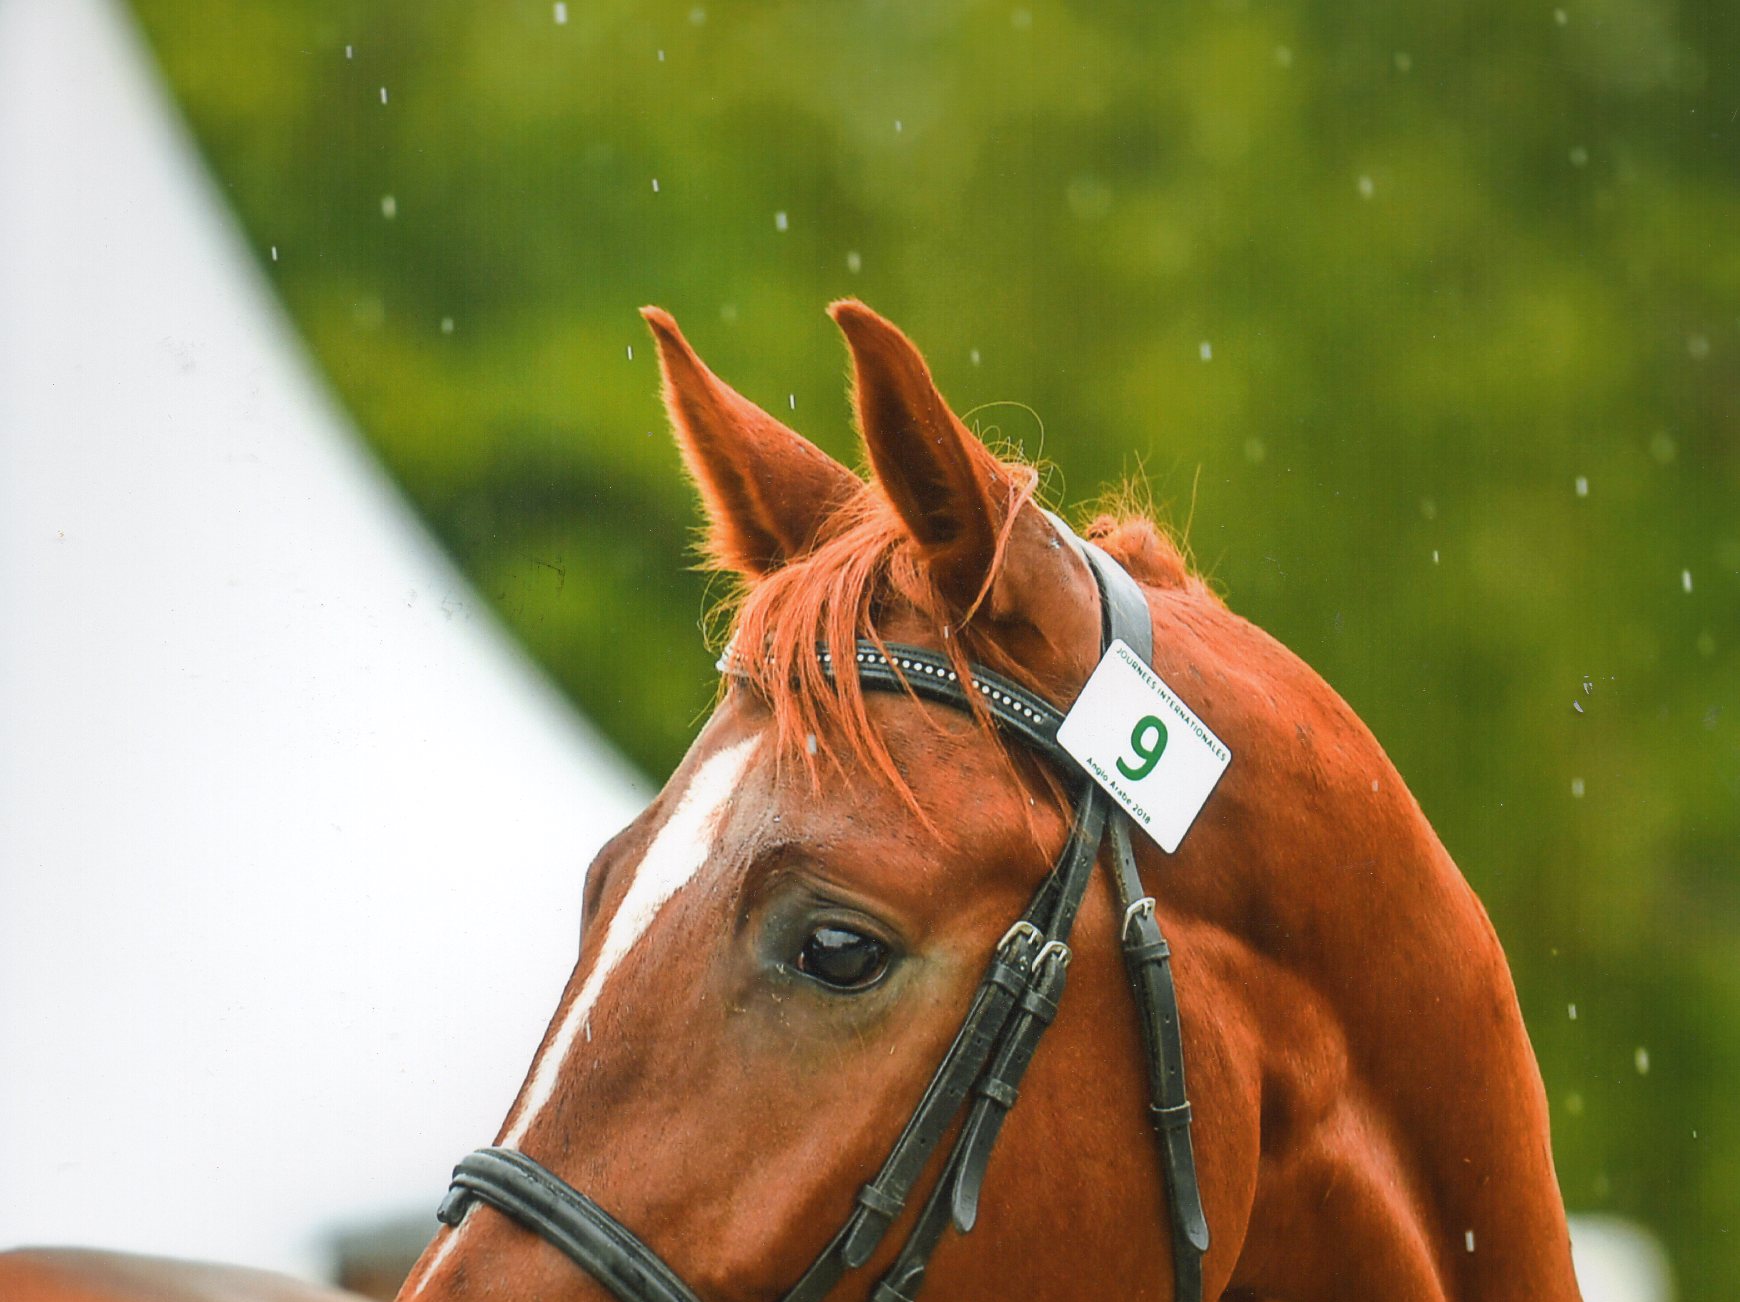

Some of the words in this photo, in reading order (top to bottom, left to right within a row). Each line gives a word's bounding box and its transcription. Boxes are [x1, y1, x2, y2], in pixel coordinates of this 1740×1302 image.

[1115, 714, 1169, 782] 9
[1157, 688, 1227, 762] INTERNATIONALES
[1086, 757, 1109, 782] Anglo
[1109, 780, 1132, 806] Arabe
[1132, 803, 1152, 824] 2018
